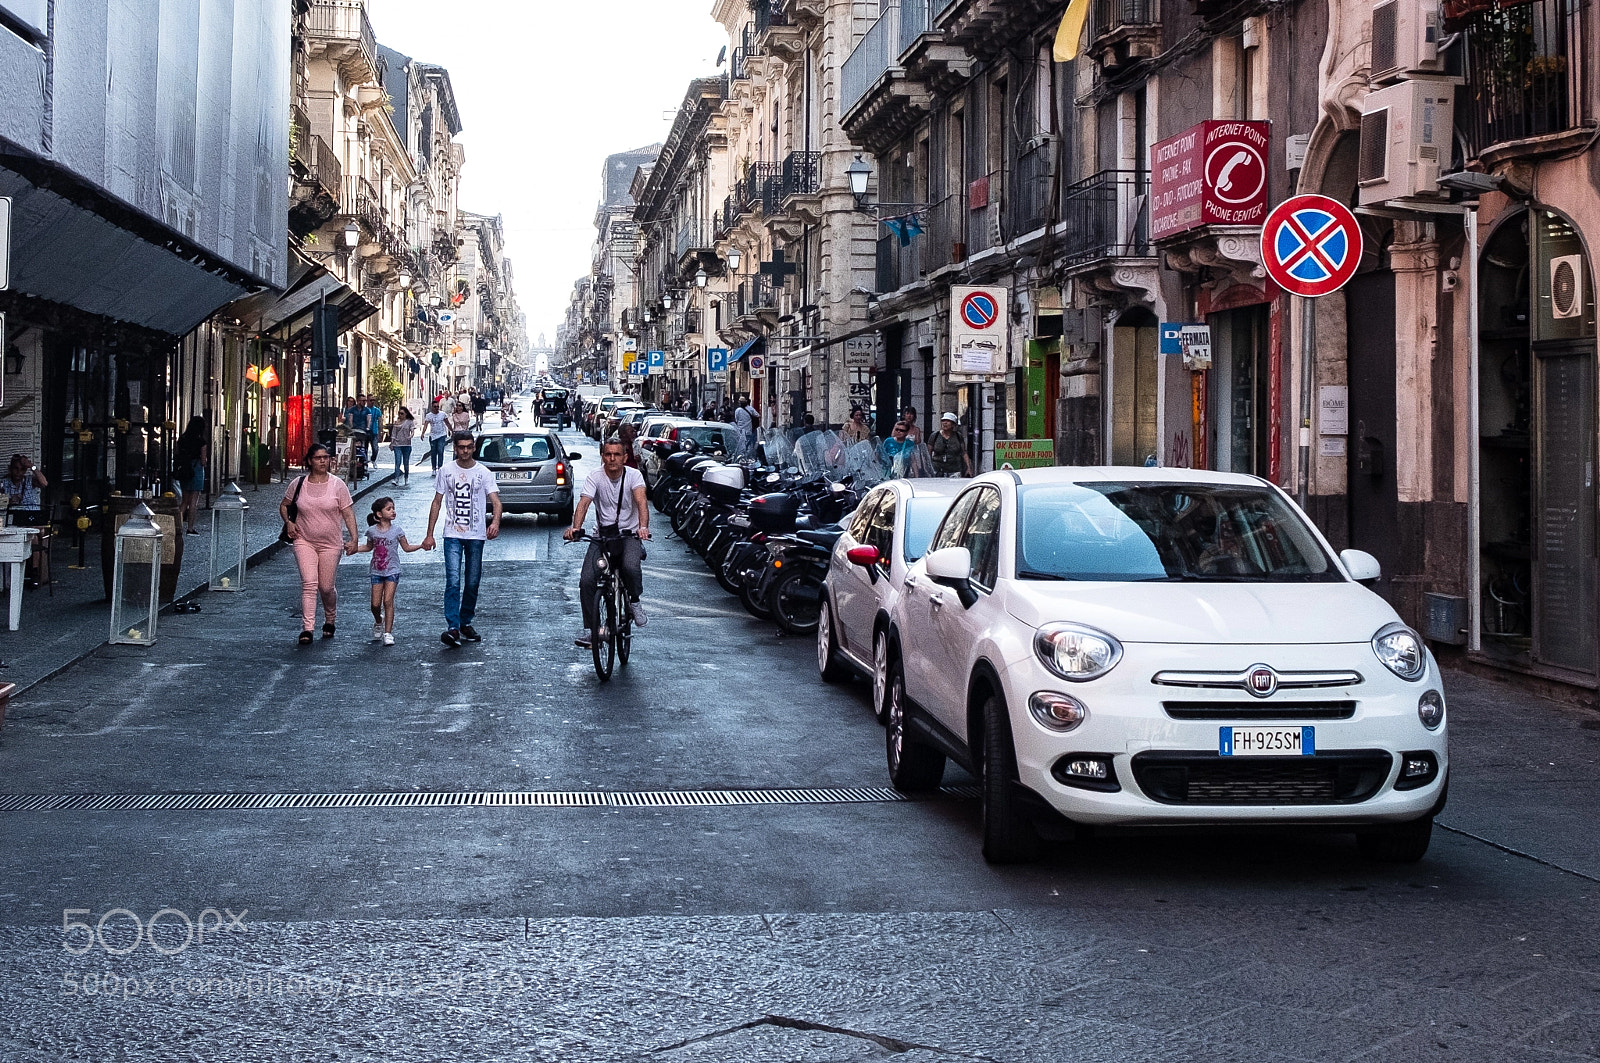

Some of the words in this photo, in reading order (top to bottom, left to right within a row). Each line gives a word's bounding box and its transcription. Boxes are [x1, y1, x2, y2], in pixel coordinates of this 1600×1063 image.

[1206, 123, 1244, 145] INTERNET
[1244, 126, 1267, 148] POINT
[1157, 139, 1180, 164] INTERNET
[1180, 132, 1197, 153] POINT
[1162, 164, 1179, 184] PHONE
[1182, 158, 1192, 176] FAX
[1163, 190, 1173, 207] DVD
[1177, 179, 1203, 202] FOTOCOPIE
[1205, 200, 1231, 221] PHONE
[1233, 202, 1264, 222] CENTER
[1270, 295, 1280, 318] FAX
[1182, 332, 1210, 346] FERMATA
[637, 362, 646, 374] P
[651, 353, 660, 365] P
[712, 351, 722, 369] P
[1004, 451, 1014, 459] ALL
[1037, 450, 1053, 458] FOOD
[455, 482, 471, 526] CERES
[1255, 675, 1270, 688] FIAT
